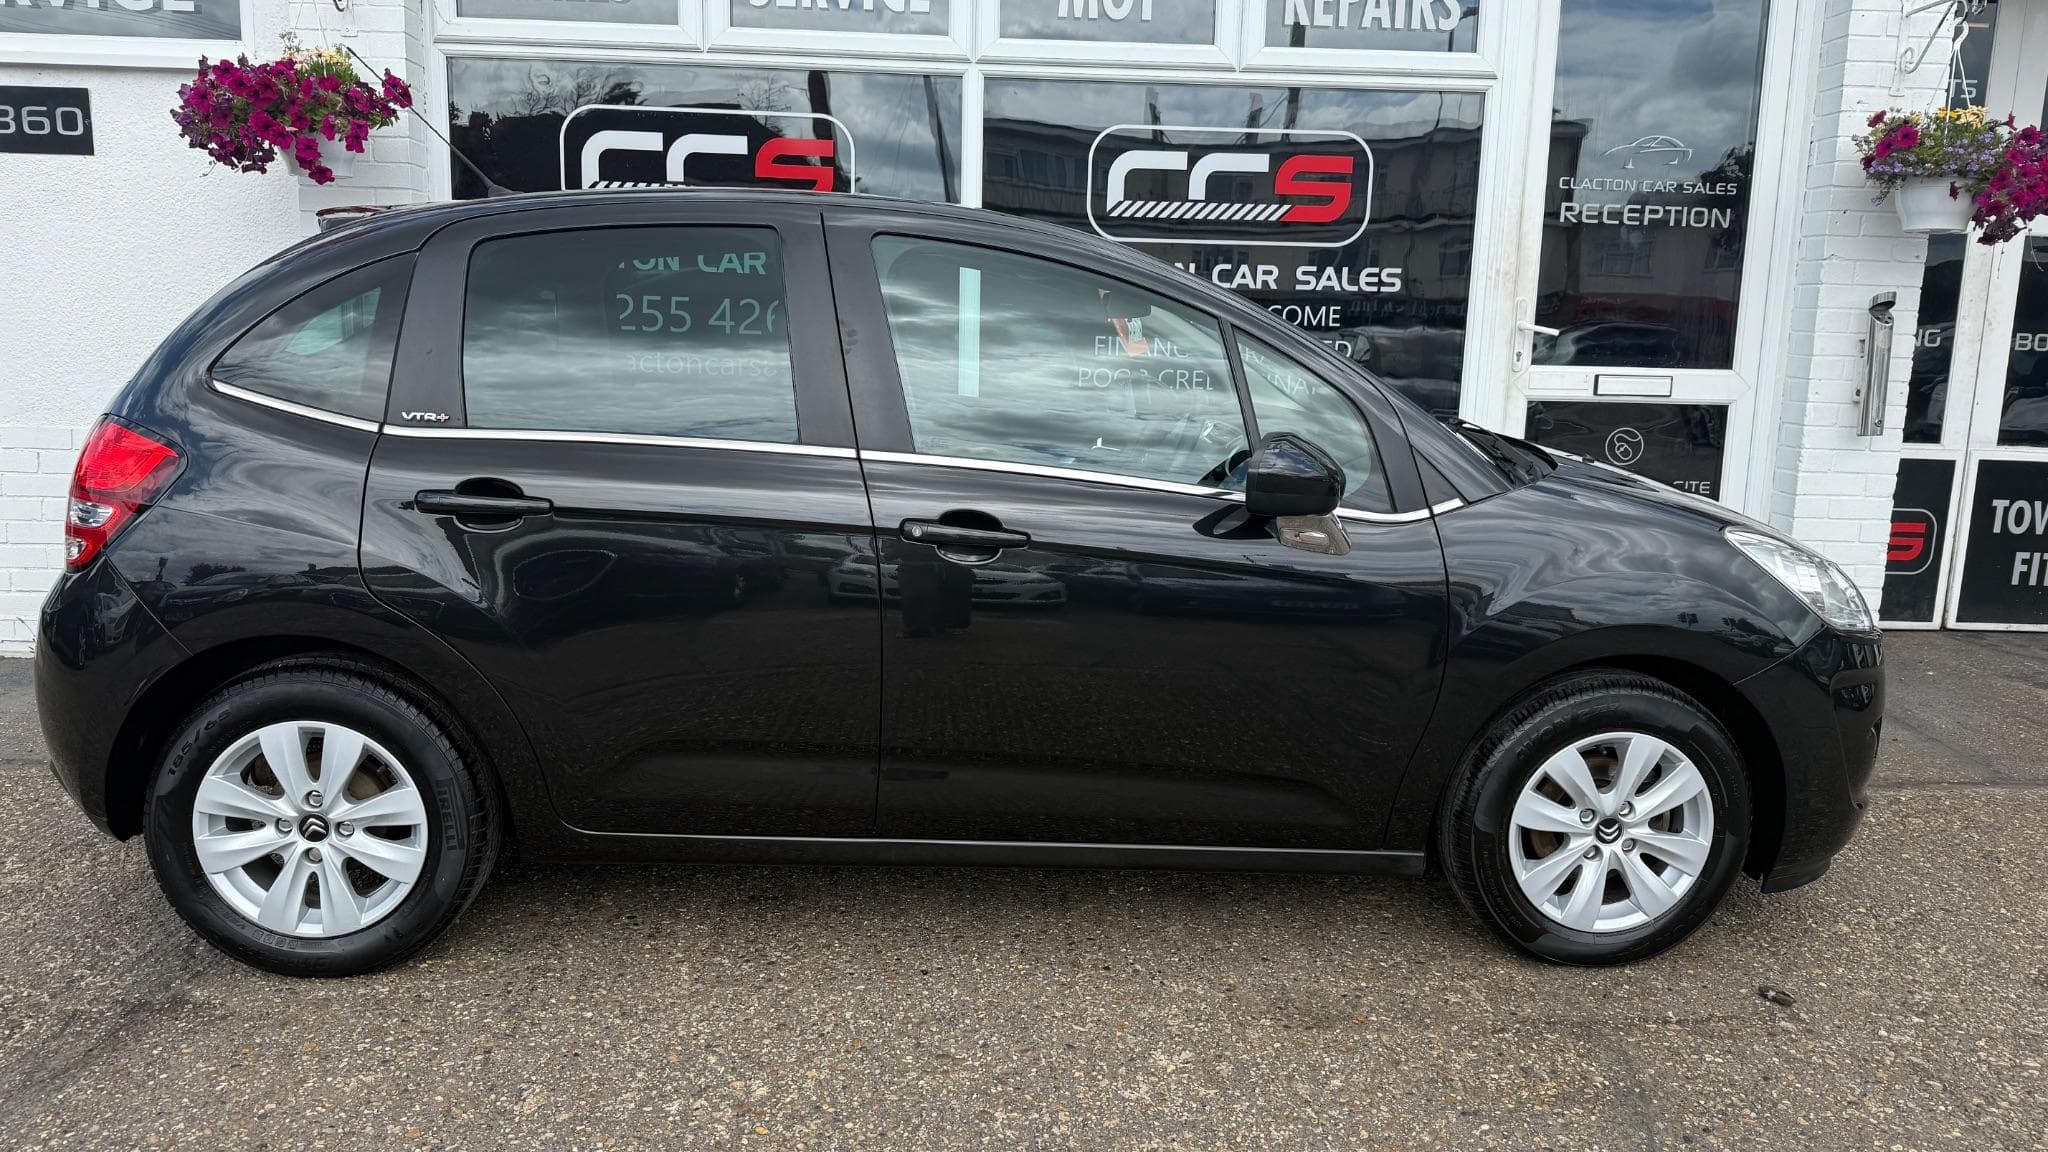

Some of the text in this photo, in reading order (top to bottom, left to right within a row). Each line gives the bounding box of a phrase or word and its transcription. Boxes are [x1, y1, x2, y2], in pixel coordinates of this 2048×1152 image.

[1559, 176, 1738, 195] CLACTON CAR SALES
[1559, 202, 1731, 228] RECEPTION
[697, 252, 766, 274] CAR
[1211, 263, 1279, 290] CAR
[1295, 266, 1402, 292] SALES
[401, 411, 450, 422] VTR+
